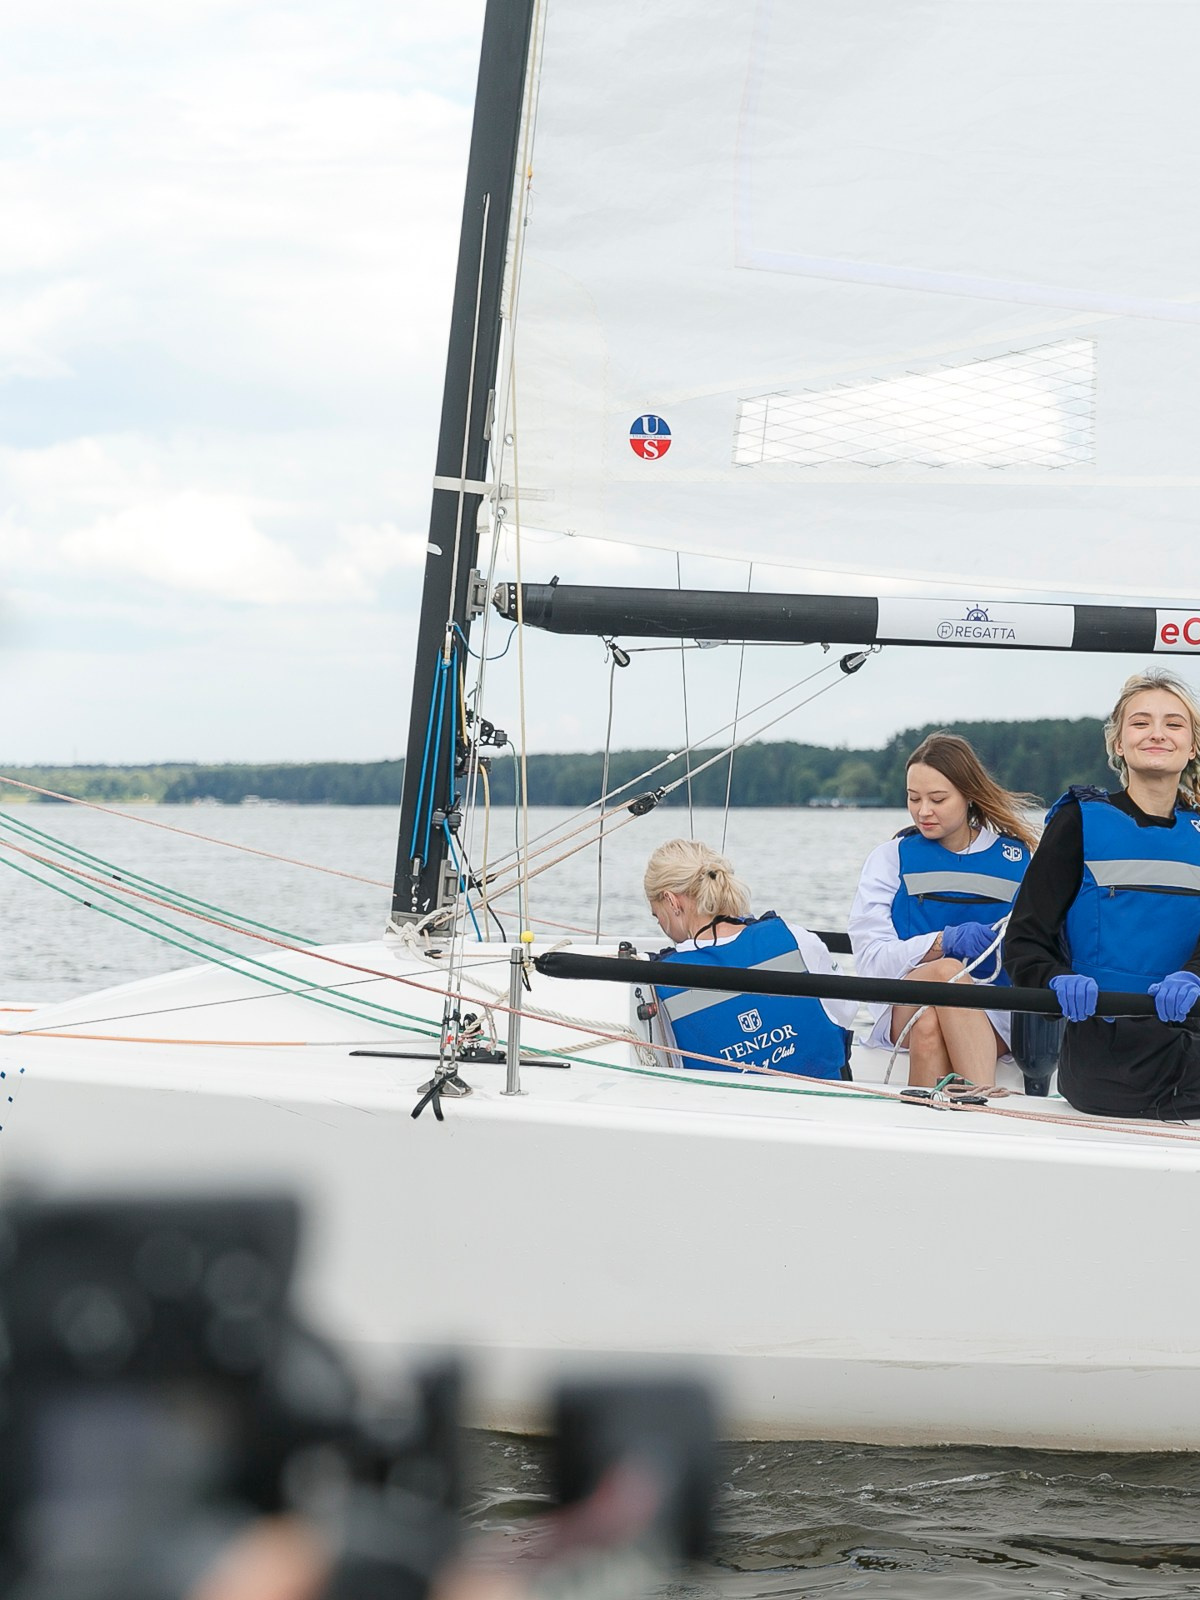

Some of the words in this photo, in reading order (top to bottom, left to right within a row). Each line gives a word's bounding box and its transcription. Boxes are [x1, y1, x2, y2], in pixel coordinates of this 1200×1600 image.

[955, 625, 1016, 639] REGATTA
[720, 1024, 798, 1061] TENZOR
[771, 1042, 796, 1064] Club
